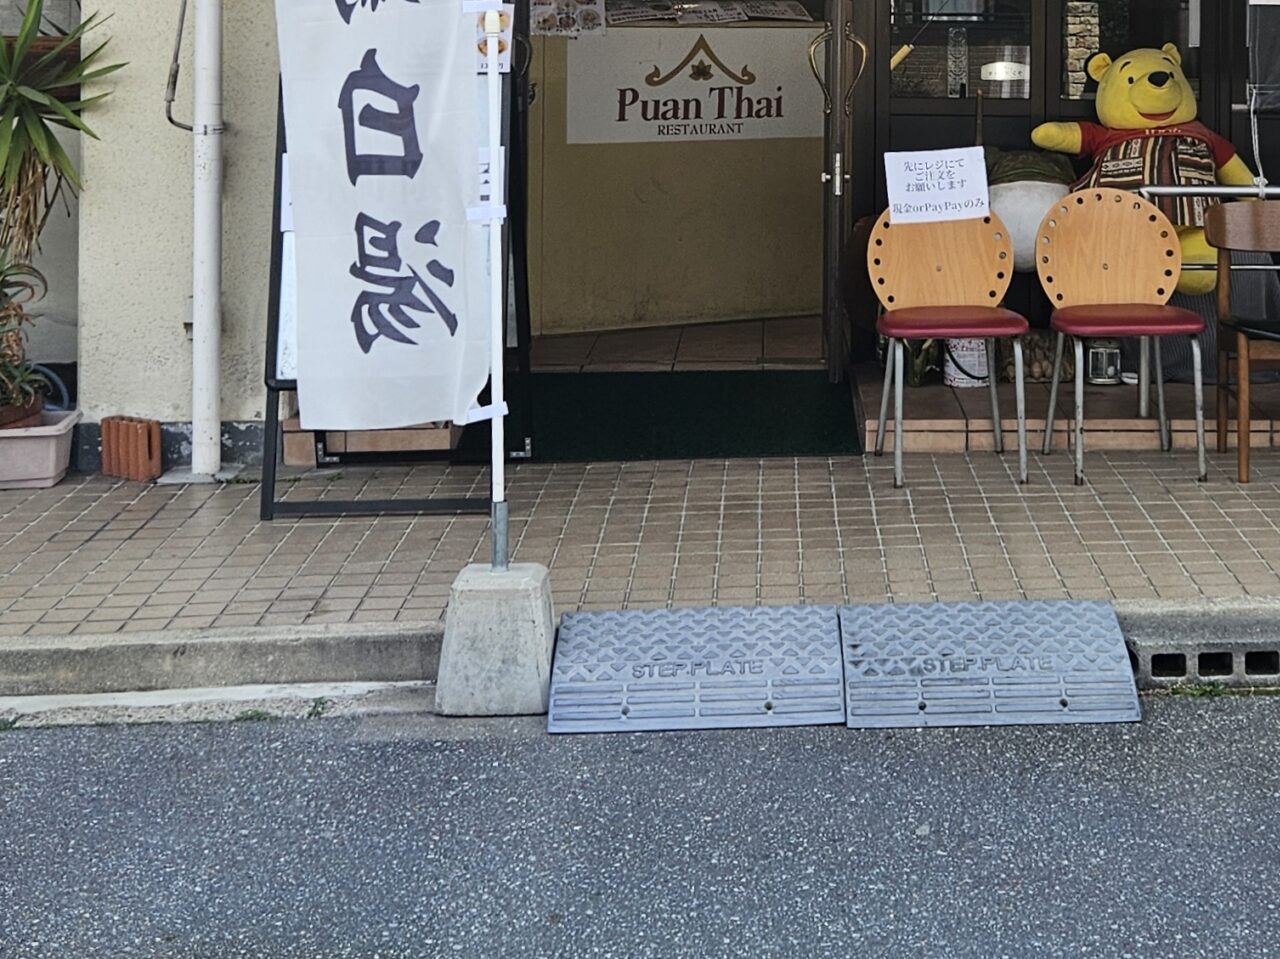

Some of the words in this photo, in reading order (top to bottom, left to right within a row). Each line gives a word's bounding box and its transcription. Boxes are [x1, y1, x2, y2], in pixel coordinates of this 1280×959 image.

[615, 88, 703, 122] Puan
[708, 86, 784, 120] Thai
[657, 123, 744, 136] RESTAURANT
[904, 159, 965, 172] 先にレジにて
[915, 170, 956, 182] ご注文を
[905, 179, 967, 192] お願いします
[893, 198, 985, 214] 現金orPayPayのみ
